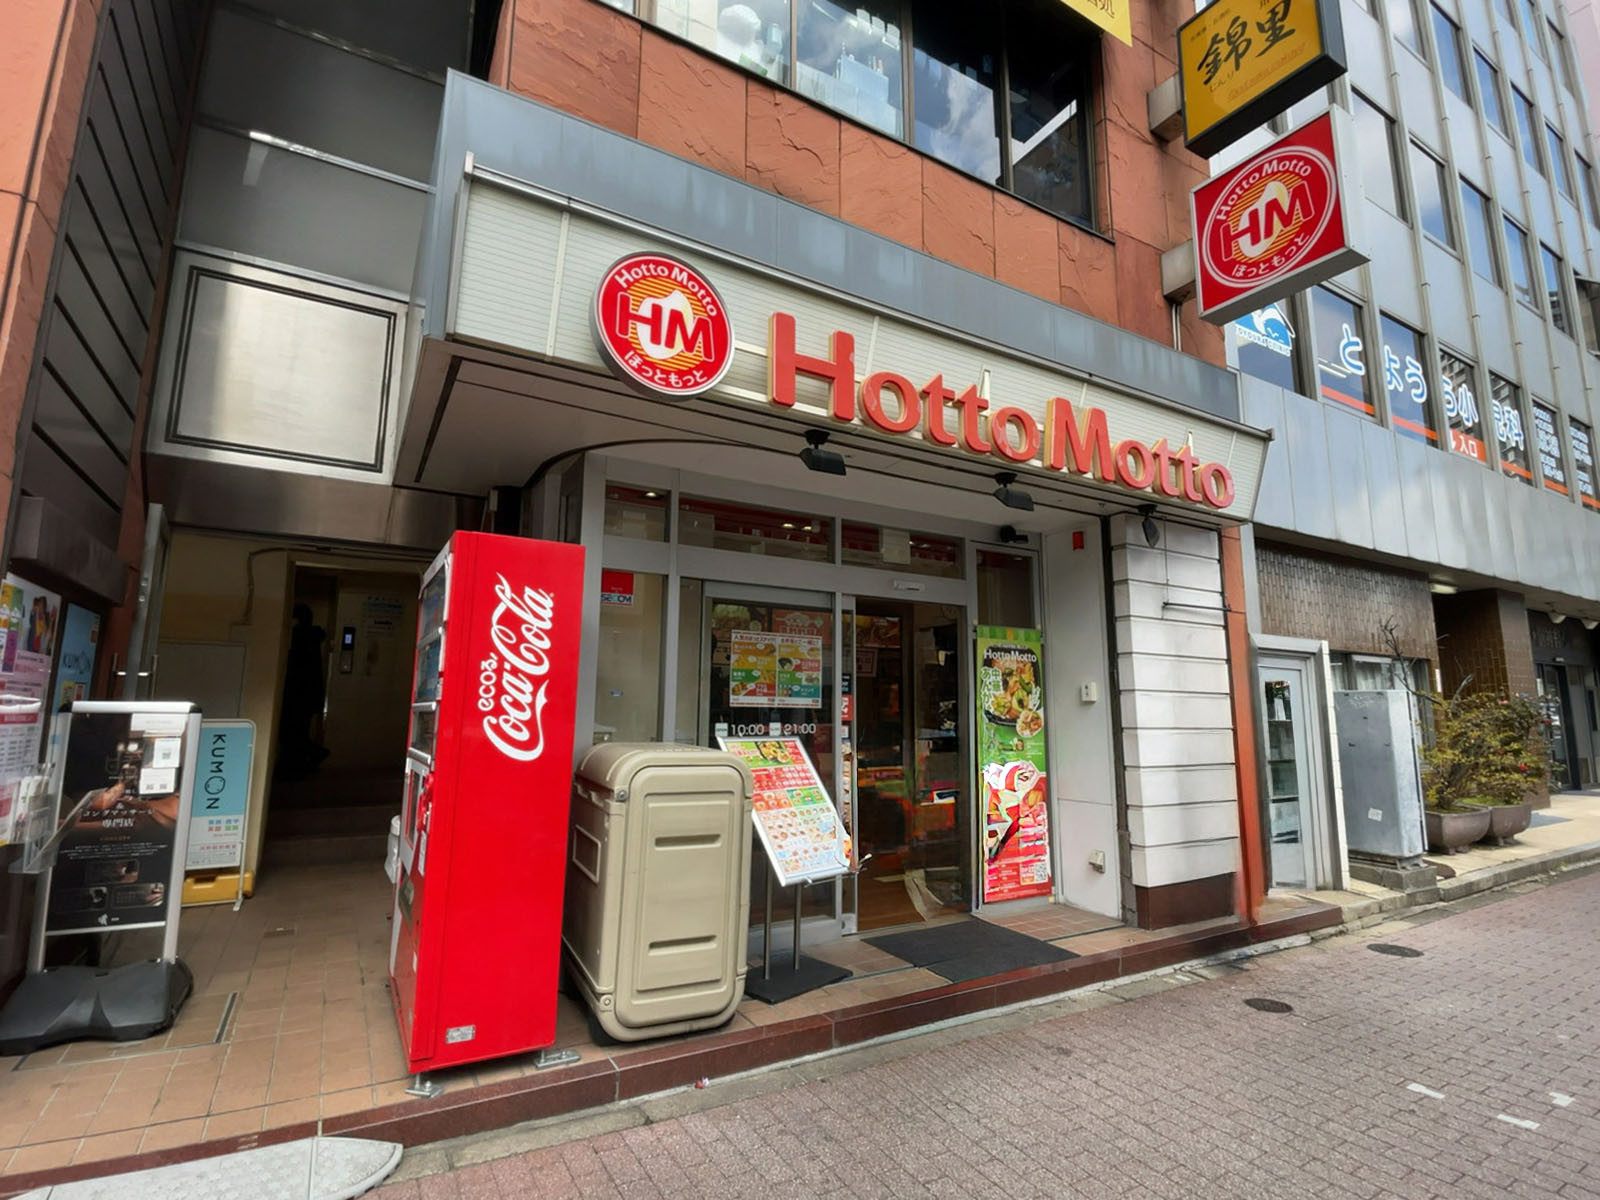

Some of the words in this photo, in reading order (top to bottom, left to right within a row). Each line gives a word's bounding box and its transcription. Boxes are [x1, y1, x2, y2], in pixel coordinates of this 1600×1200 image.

[1232, 232, 1310, 278] ほっともっと
[615, 291, 715, 362] HM
[624, 350, 708, 388] ほっともっと
[1459, 435, 1479, 458] 入口
[482, 571, 555, 762] Coca-Cola
[204, 733, 227, 810] KUMON
